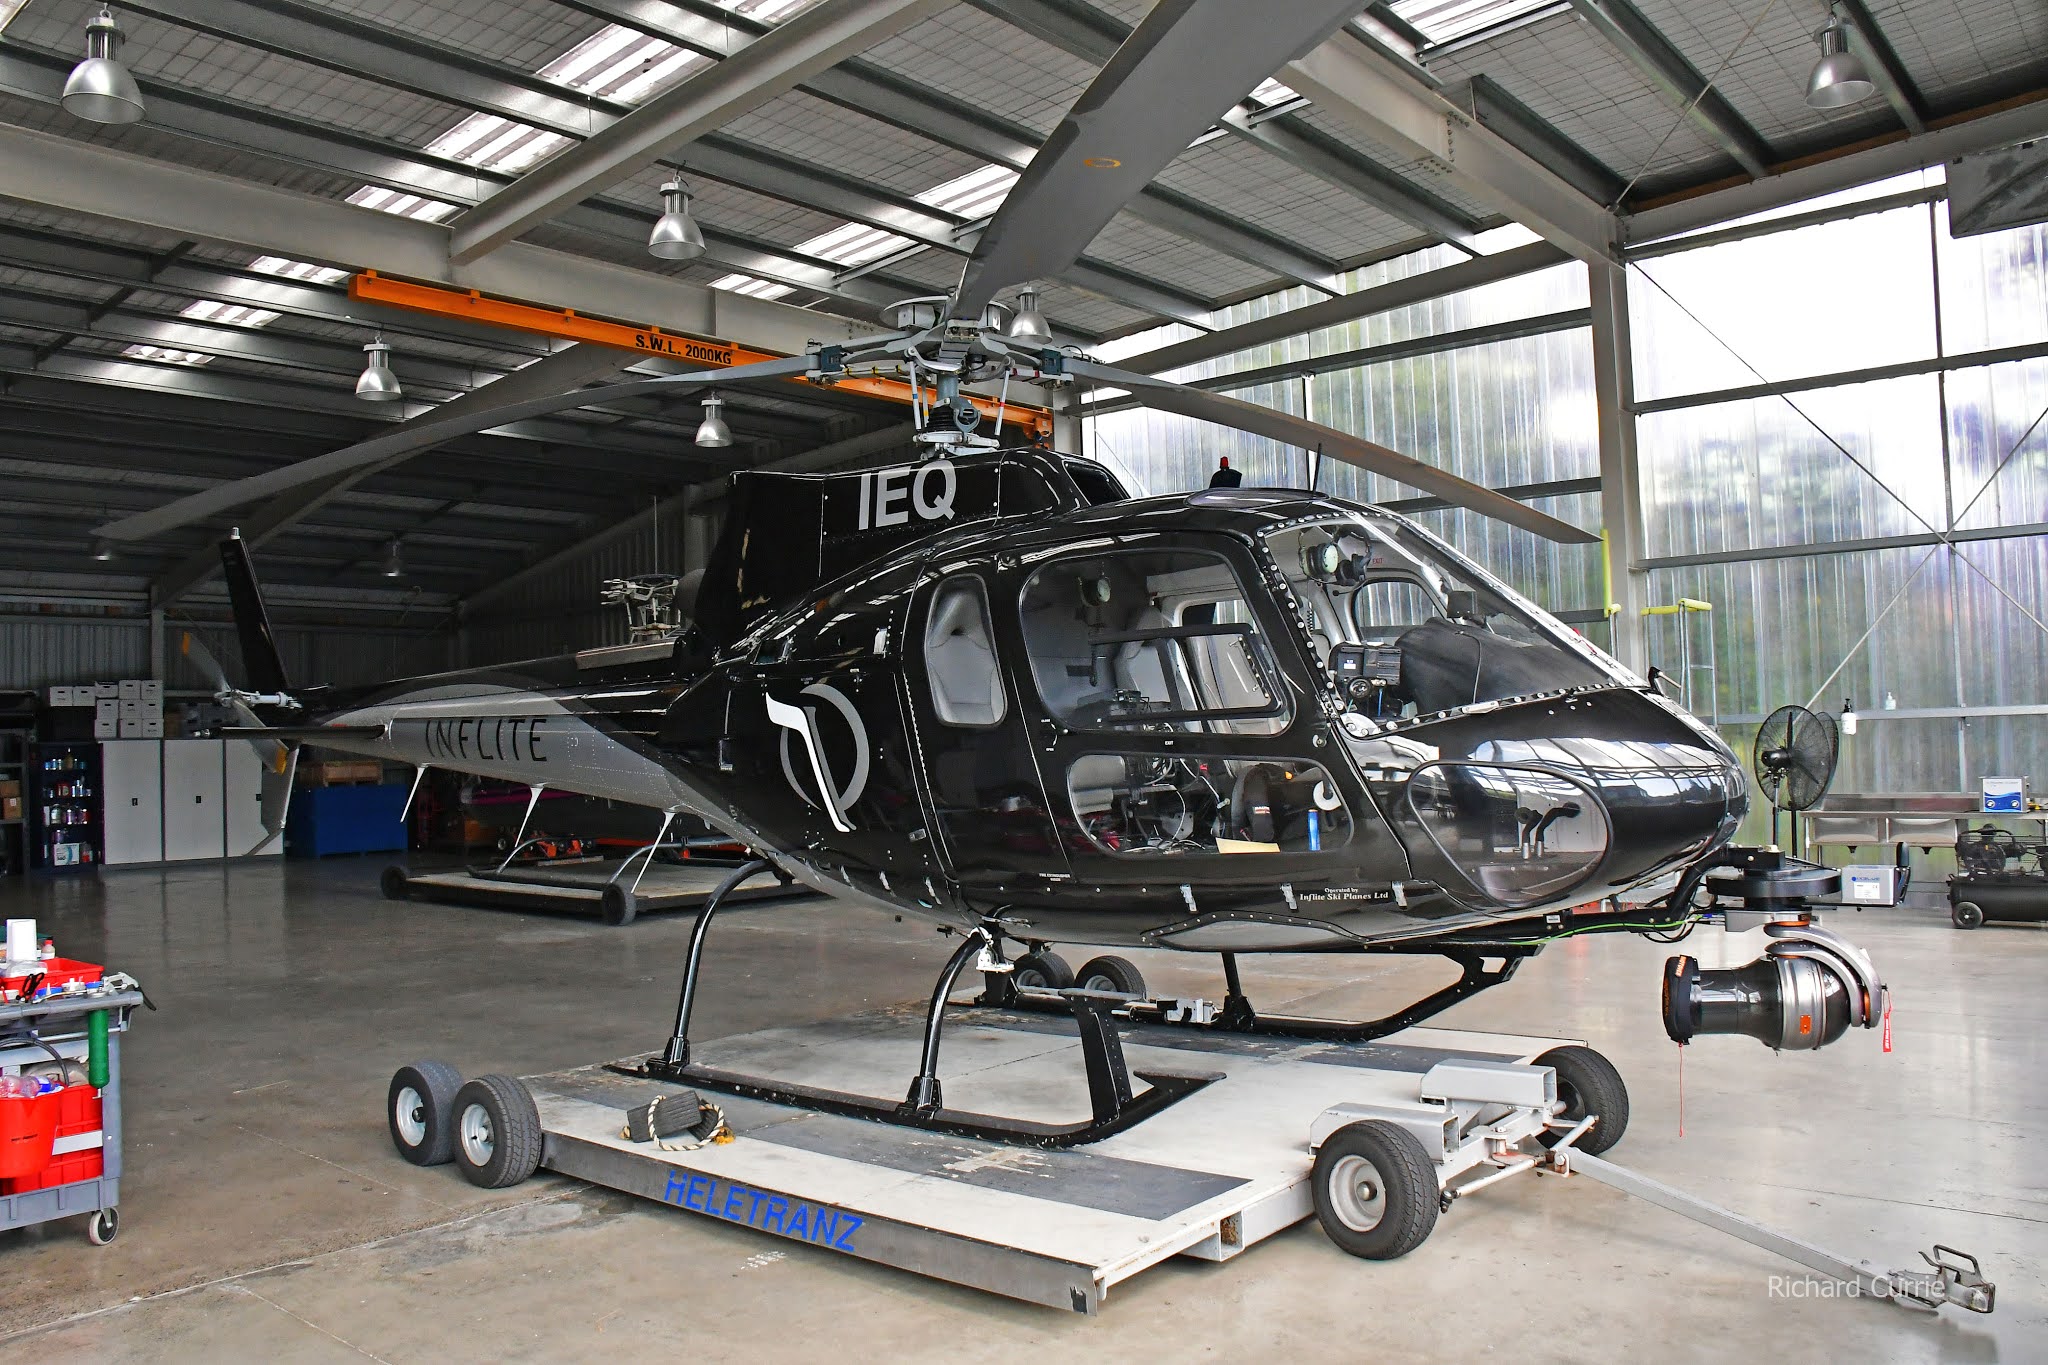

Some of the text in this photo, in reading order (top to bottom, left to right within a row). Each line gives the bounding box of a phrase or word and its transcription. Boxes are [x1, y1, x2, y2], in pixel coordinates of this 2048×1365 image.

[635, 334, 732, 365] S.W.L. 2000KG
[859, 460, 957, 531] IEQ
[425, 718, 548, 762] INFLITE
[1300, 893, 1326, 902] Inflite
[1327, 893, 1341, 901] Ski
[664, 1170, 865, 1252] HELETRANZ
